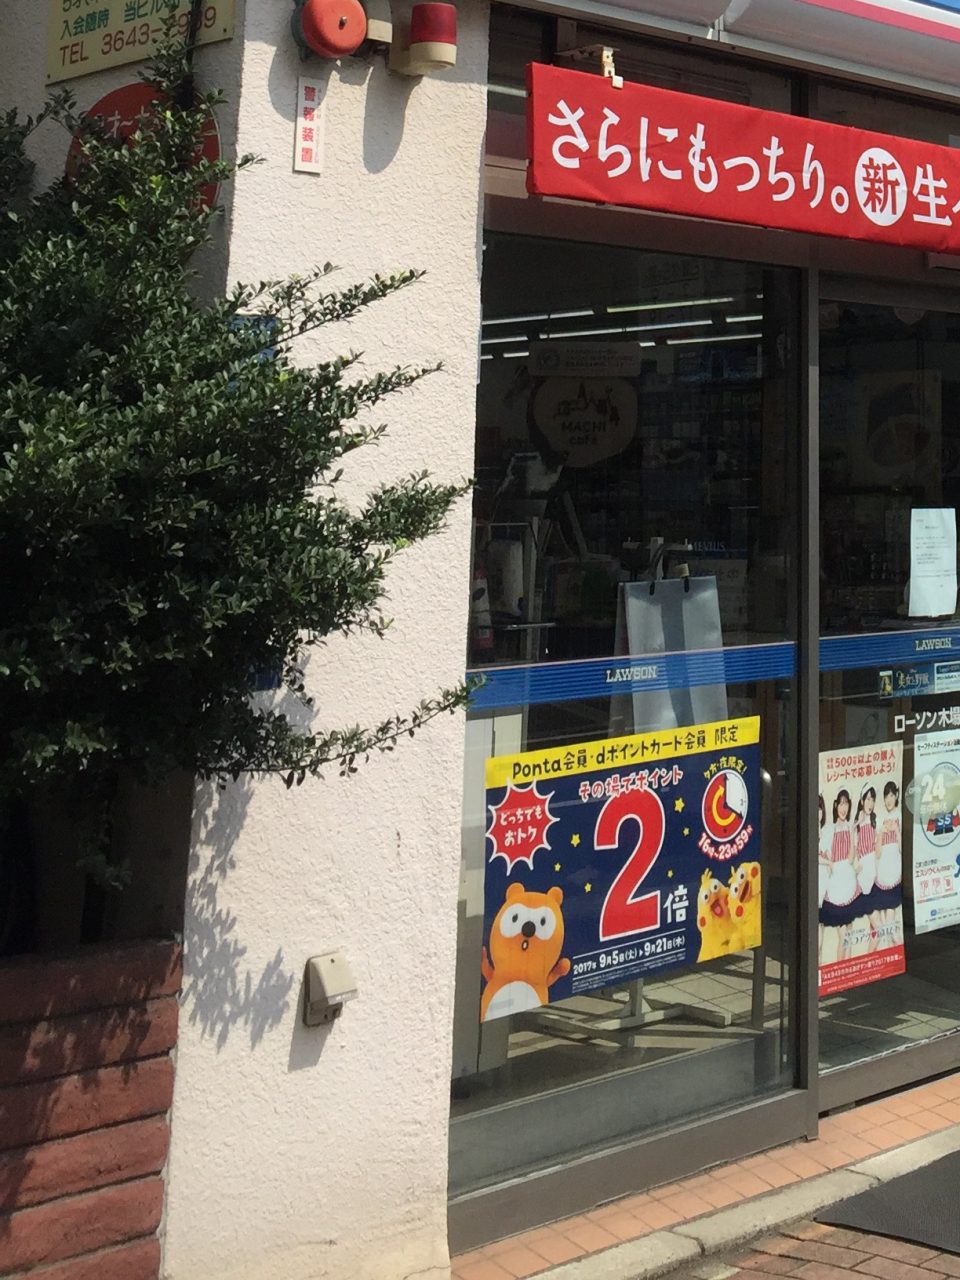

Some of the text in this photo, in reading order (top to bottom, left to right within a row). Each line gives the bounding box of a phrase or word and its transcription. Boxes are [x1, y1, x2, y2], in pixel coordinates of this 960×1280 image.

[59, 42, 90, 67] TEL
[915, 637, 952, 651] LAWSON
[605, 664, 658, 686] LAWSON
[578, 765, 684, 801] その場でポイント
[500, 806, 543, 825] どっちでも
[504, 825, 537, 846] おトク
[662, 884, 689, 925] 倍
